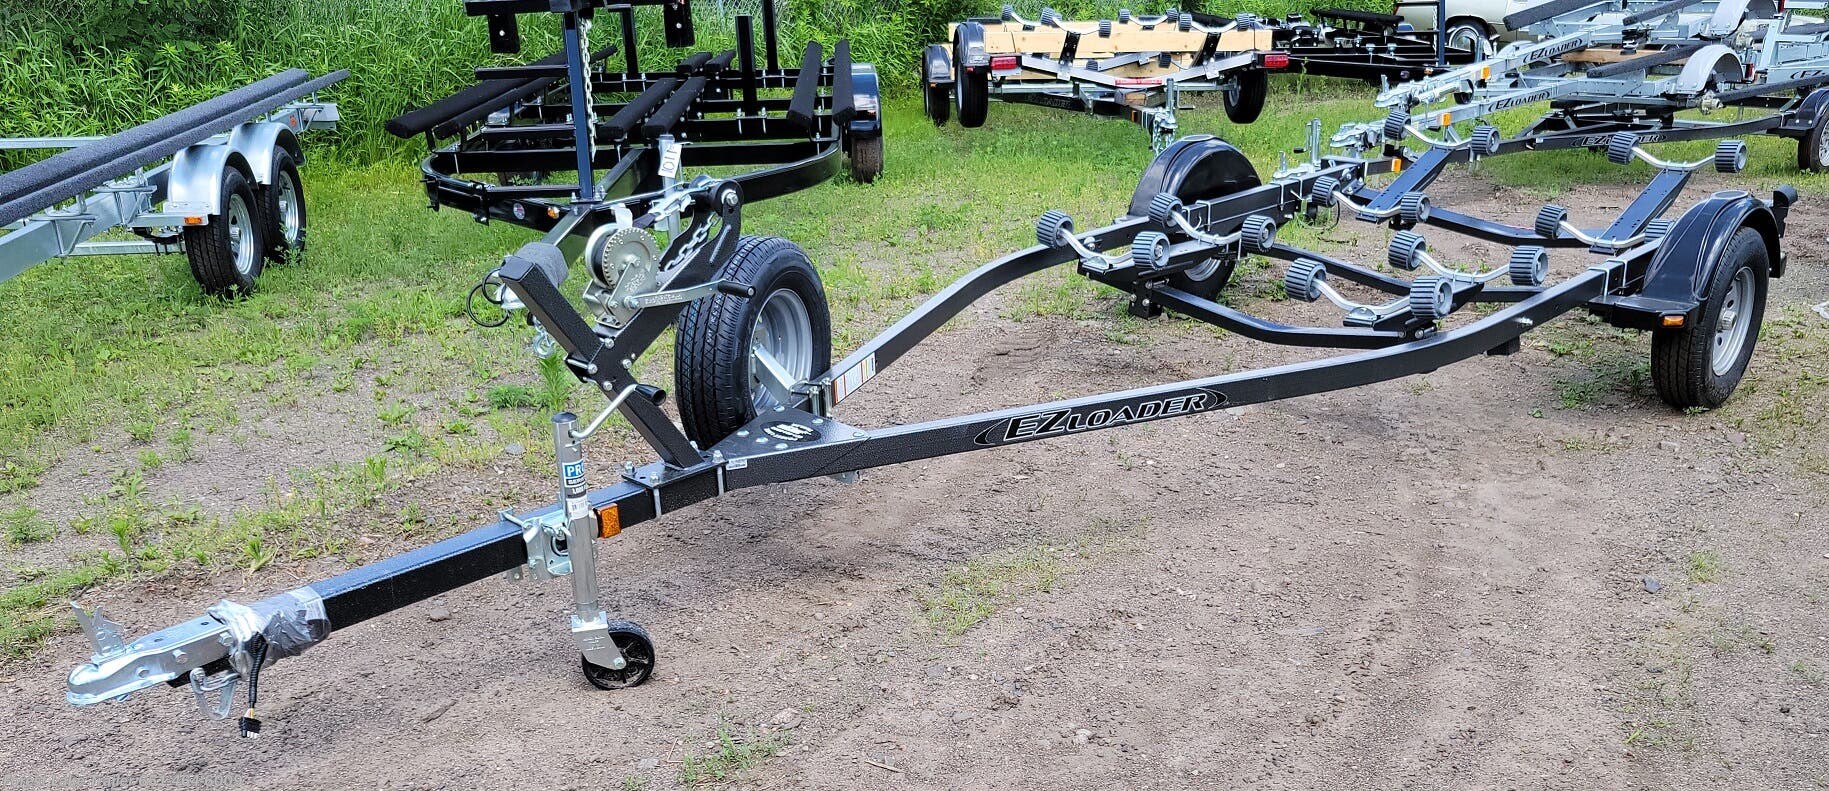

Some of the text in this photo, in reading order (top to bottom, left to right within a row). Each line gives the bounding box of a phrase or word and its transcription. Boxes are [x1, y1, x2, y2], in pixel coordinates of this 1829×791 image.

[1530, 39, 1578, 61] EZLOADER
[1495, 92, 1546, 110] EZLOADER
[1004, 394, 1207, 441] EZLOADER
